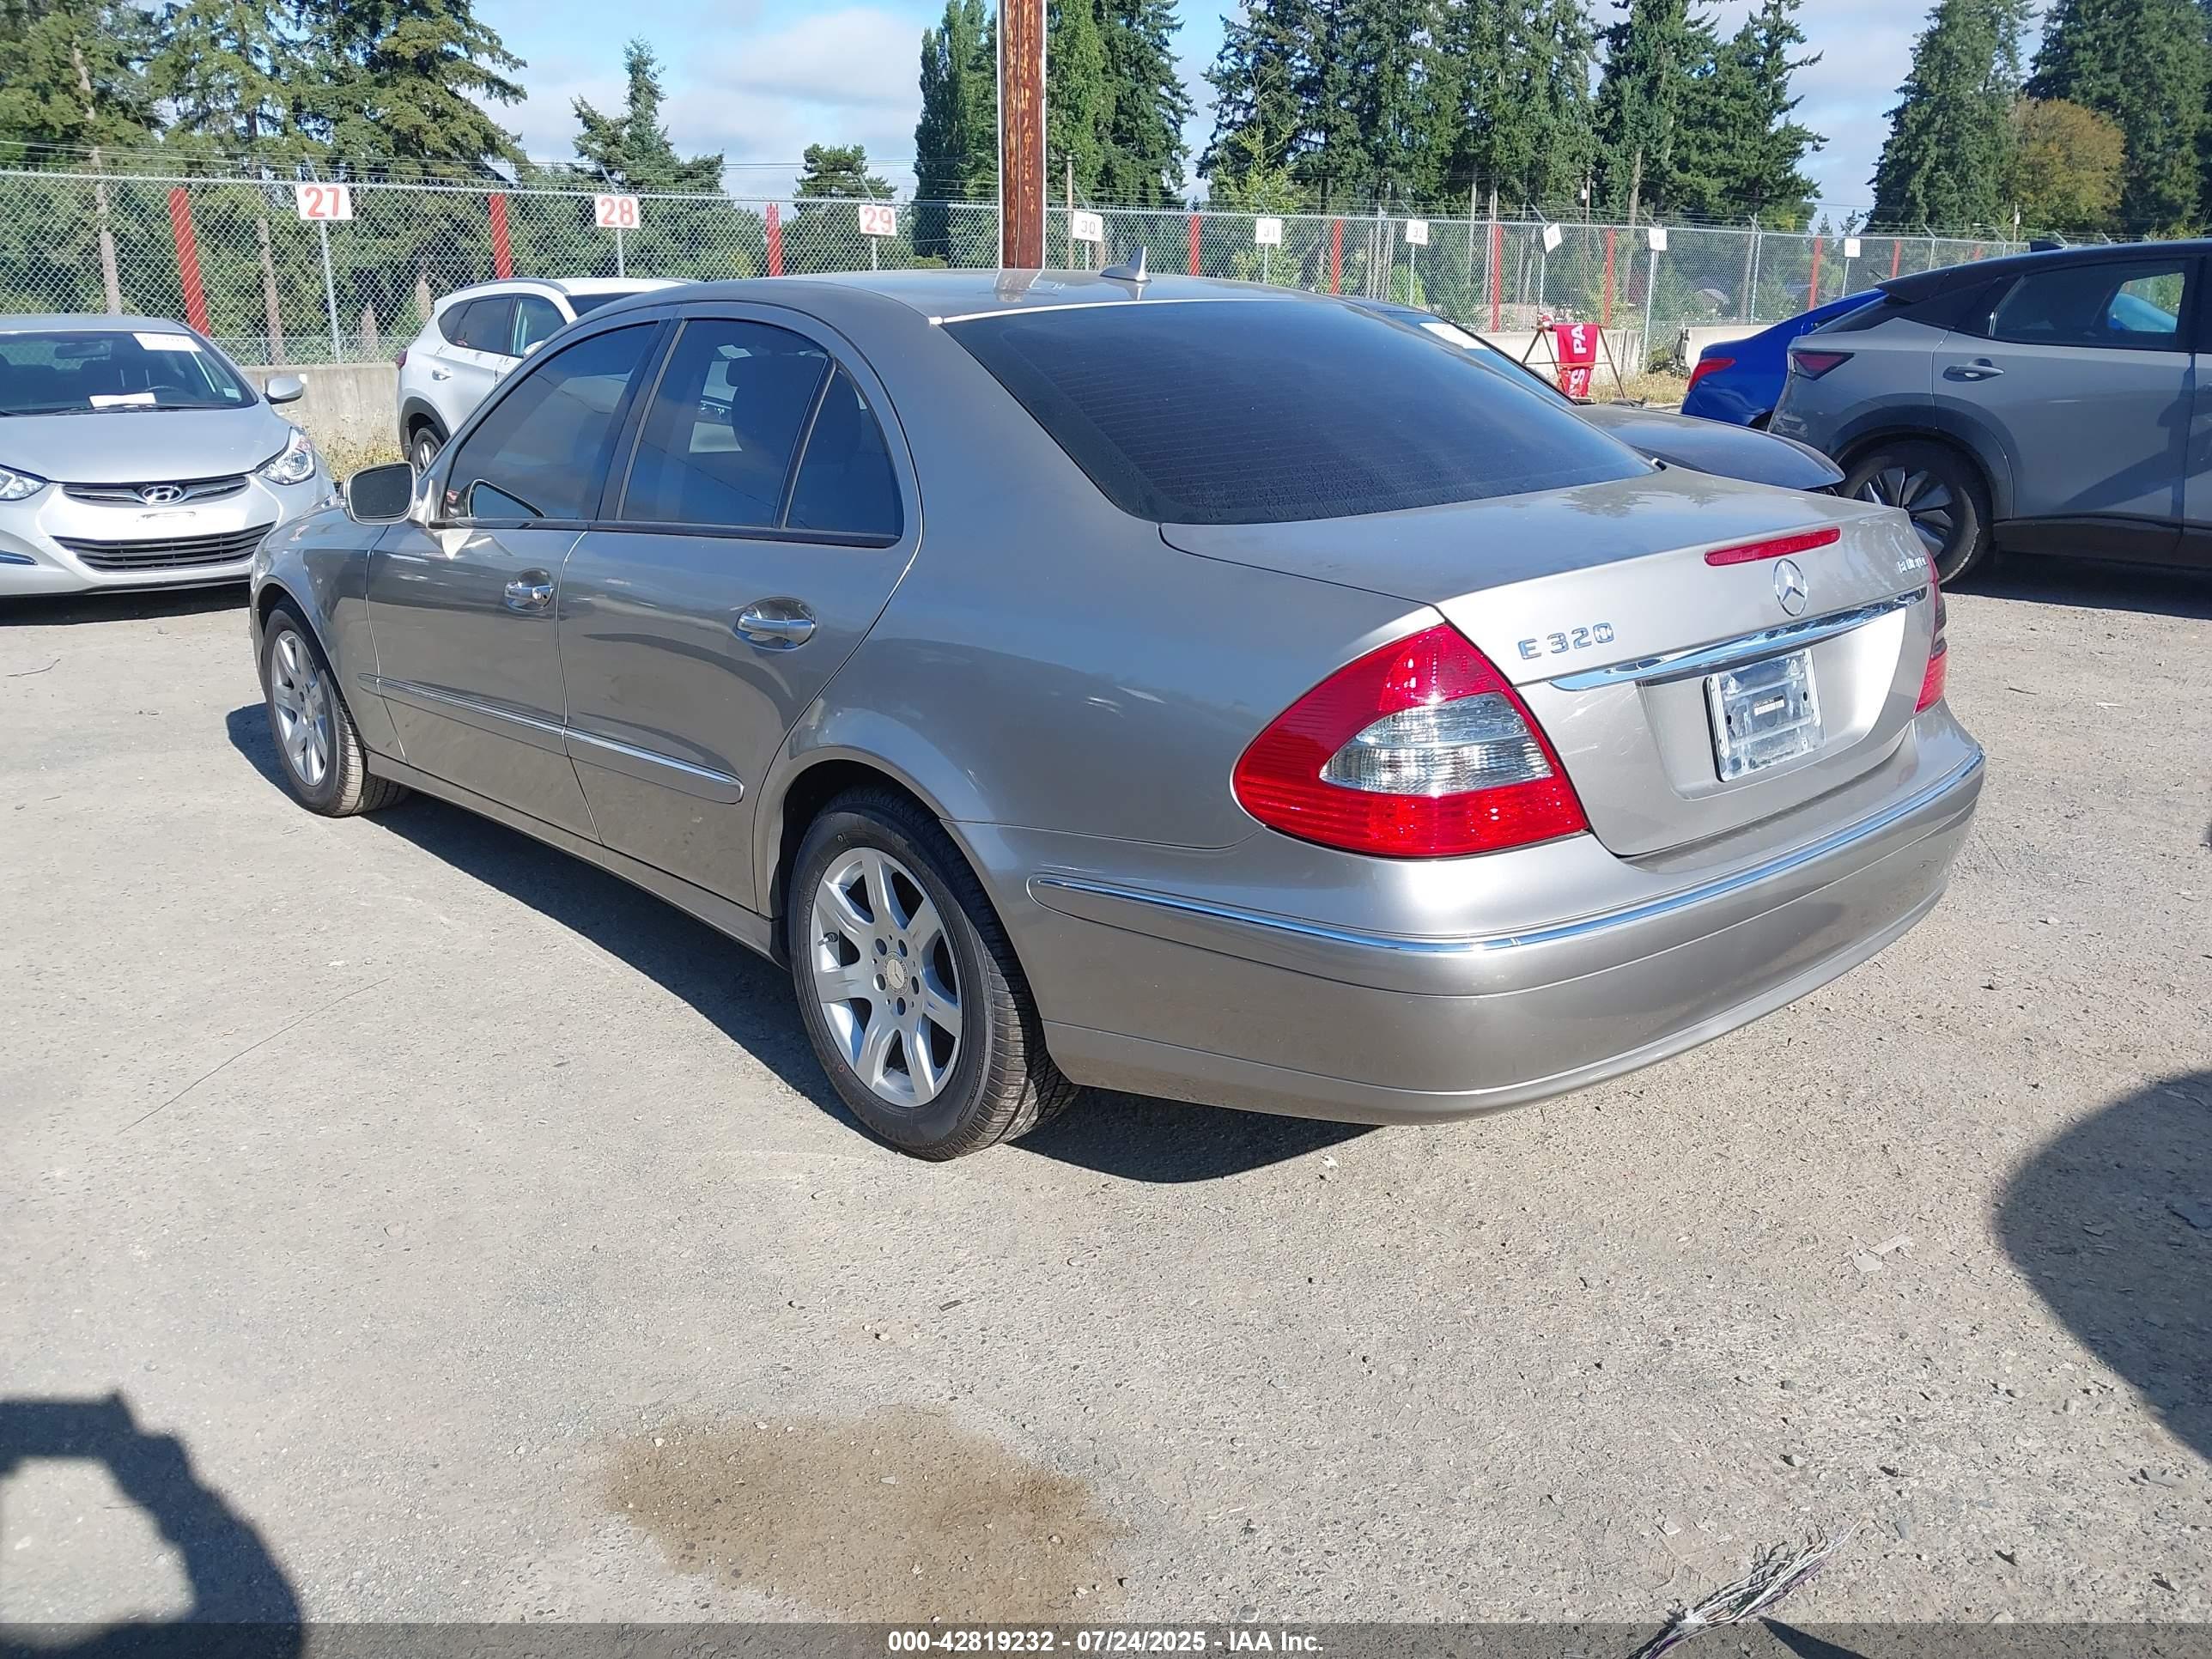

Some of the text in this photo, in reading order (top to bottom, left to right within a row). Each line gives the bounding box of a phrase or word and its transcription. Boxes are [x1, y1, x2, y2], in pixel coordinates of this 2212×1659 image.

[305, 186, 340, 217] 27
[601, 198, 634, 227] 28
[865, 207, 892, 234] 29
[1080, 220, 1096, 234] 30
[1517, 622, 1615, 660] E 320
